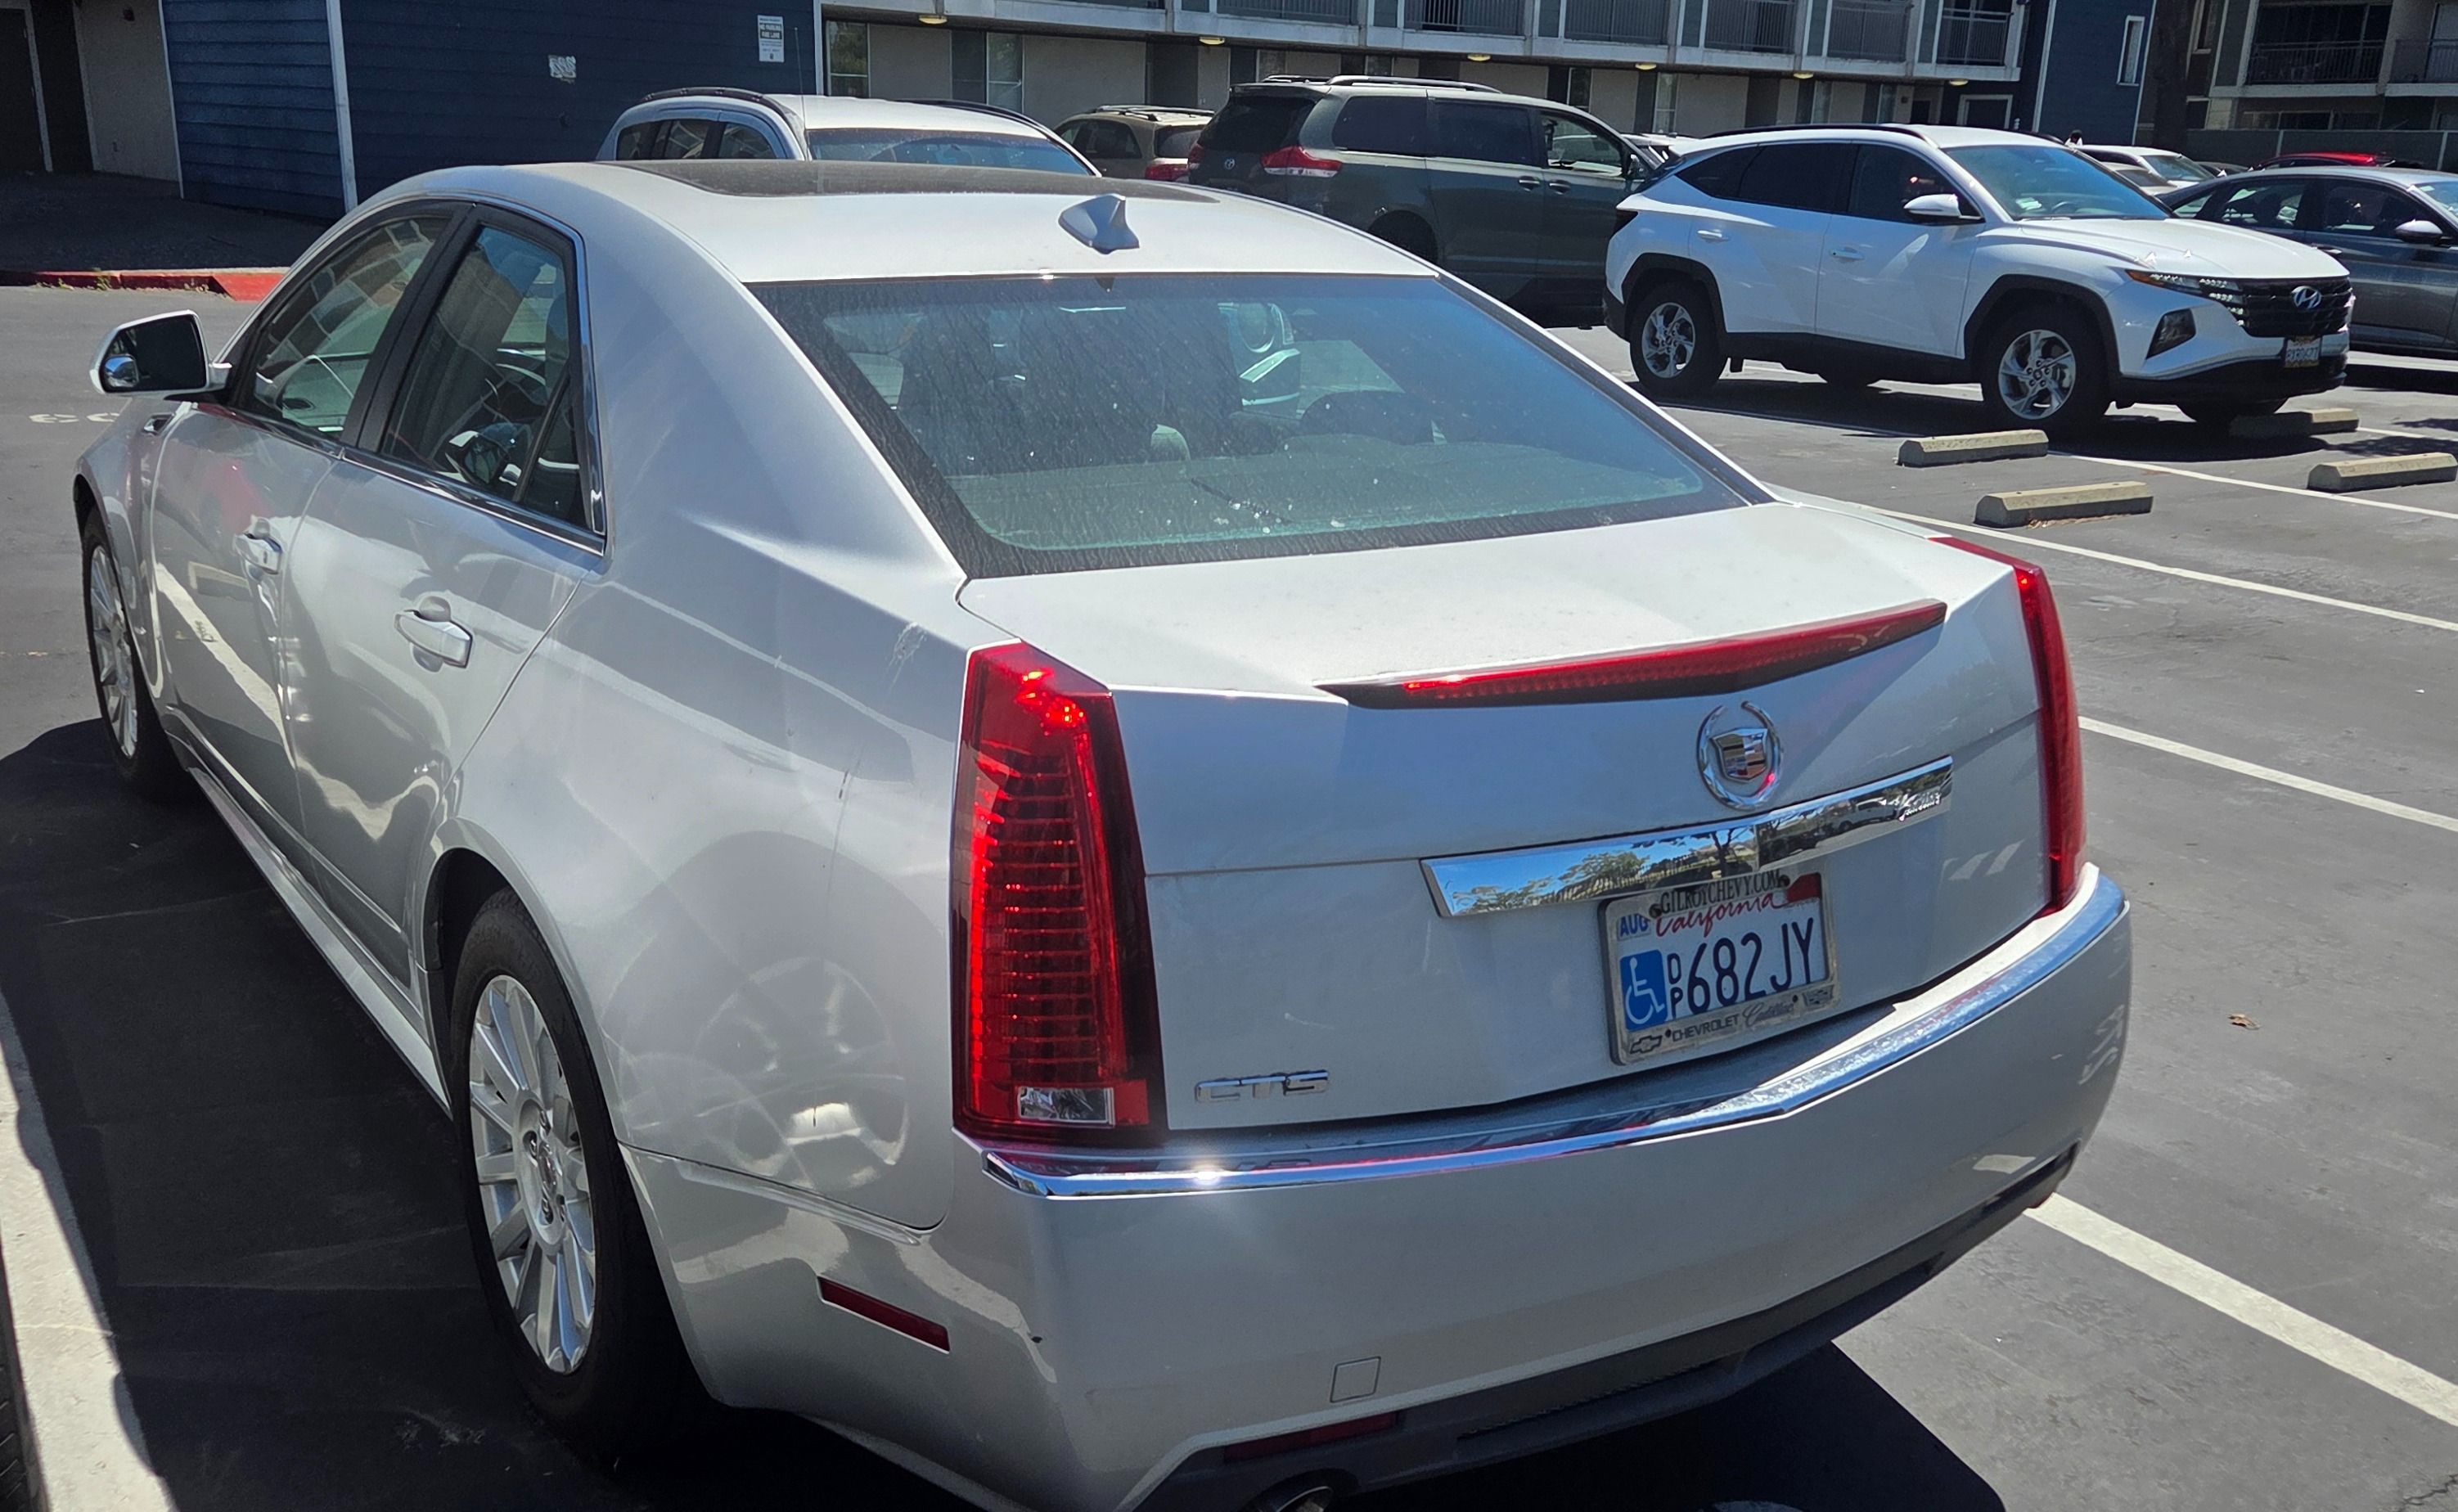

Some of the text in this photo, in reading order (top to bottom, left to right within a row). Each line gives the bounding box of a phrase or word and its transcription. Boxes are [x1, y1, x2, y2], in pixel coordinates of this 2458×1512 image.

[1660, 869, 1780, 914] GILROYCHEVY.COM
[1620, 913, 1649, 938] AUG
[1672, 1014, 1740, 1042] CHEVROLET
[1195, 1069, 1330, 1103] CTS
